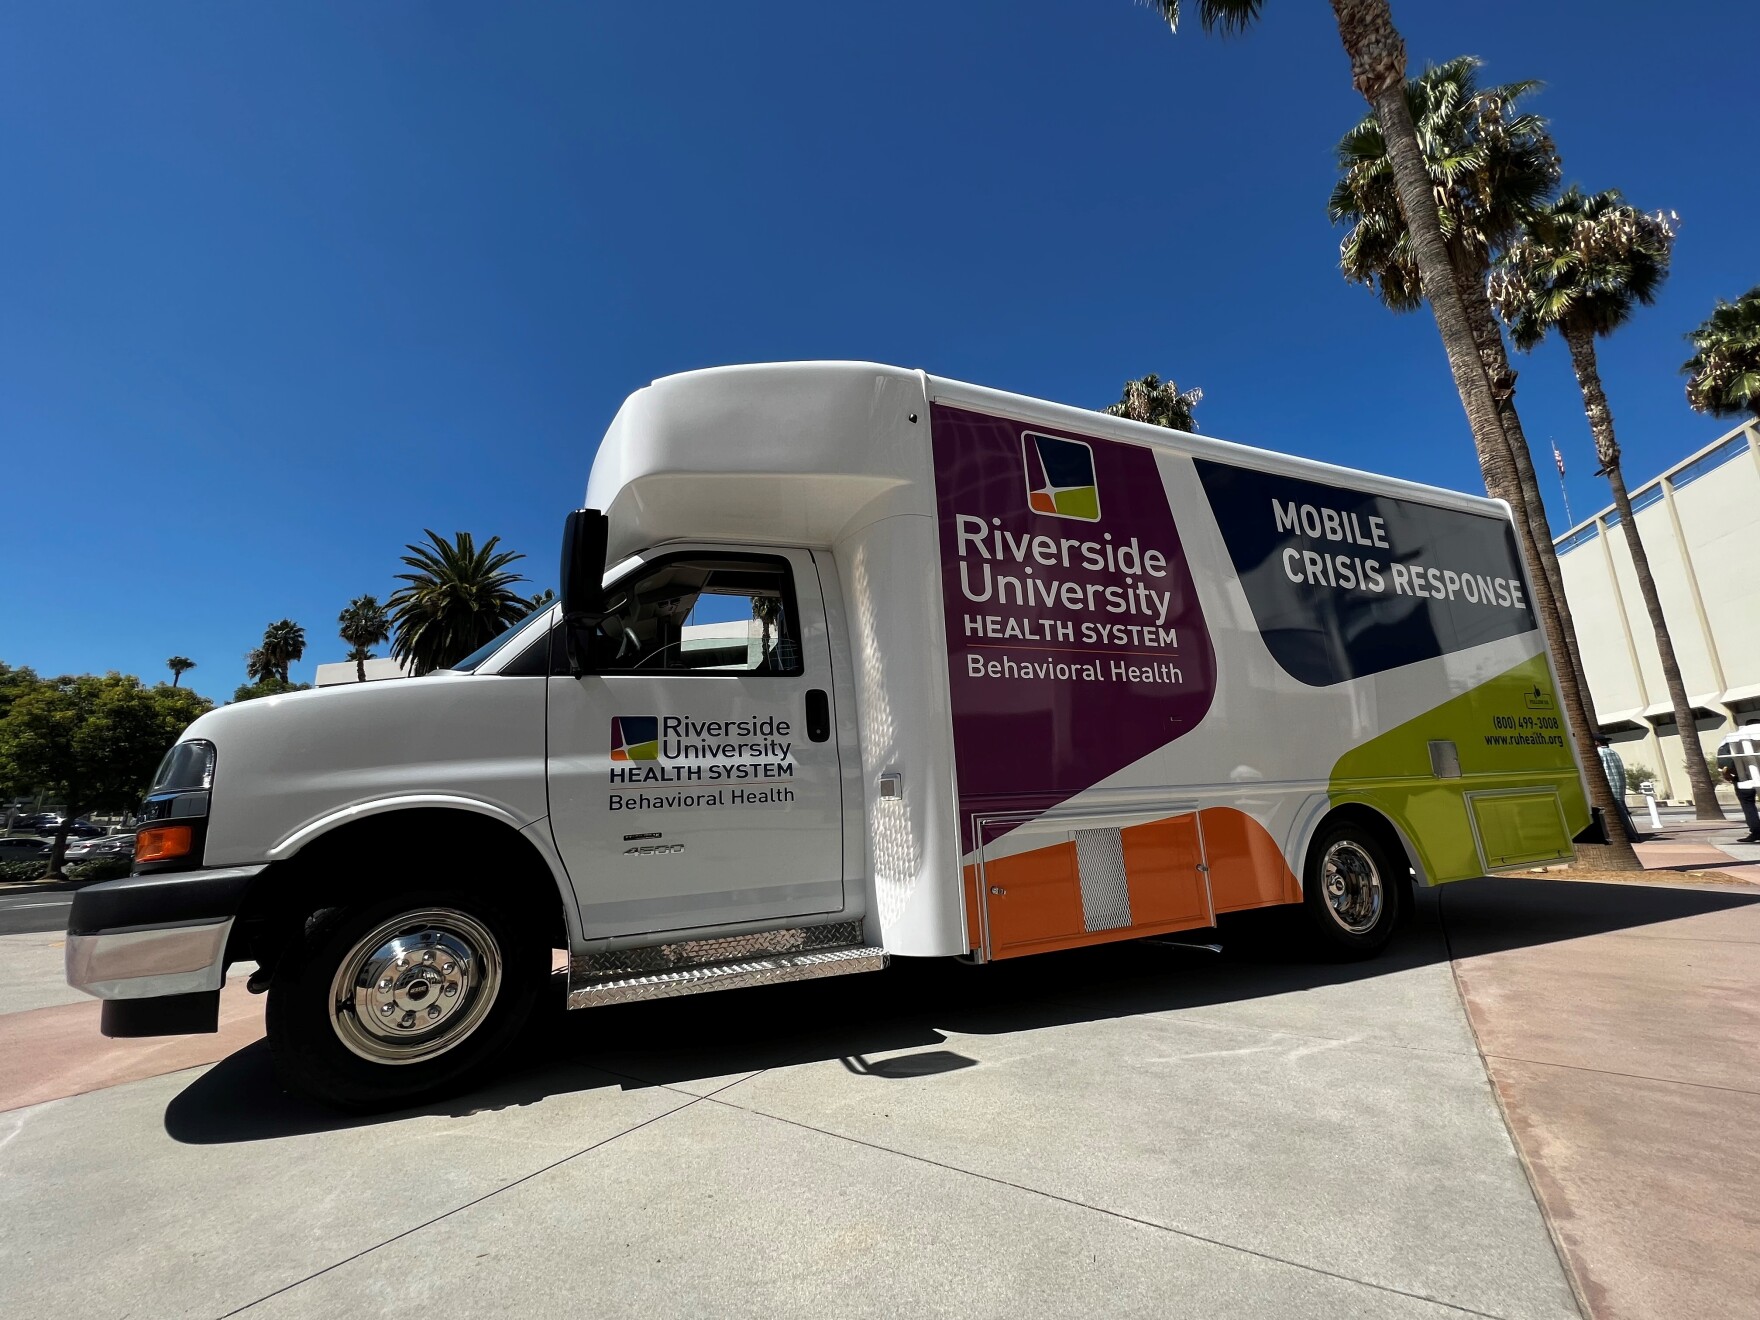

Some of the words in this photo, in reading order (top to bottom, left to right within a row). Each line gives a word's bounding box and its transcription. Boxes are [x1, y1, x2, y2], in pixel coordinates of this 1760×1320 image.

[1272, 498, 1390, 549] MOBILE
[955, 513, 1167, 578] Riverside
[1282, 547, 1386, 593] CRISIS
[1390, 562, 1527, 609] RESPONSE
[959, 560, 1171, 625] University
[964, 614, 1074, 643] HEALTH
[1081, 622, 1178, 648] SYSTEM
[966, 654, 1104, 682] Behavioral
[1110, 660, 1183, 684] Health
[663, 715, 791, 738] Riverside
[1493, 715, 1517, 731] (800)
[1518, 717, 1559, 730] 499-3008
[663, 738, 792, 761] University
[1484, 732, 1564, 747] www.ruhealth.org
[609, 765, 702, 784] HEALTH
[708, 762, 794, 780] SYSTEM
[609, 790, 725, 811] Behavioral
[731, 787, 795, 805] Health
[623, 843, 685, 857] 4500
